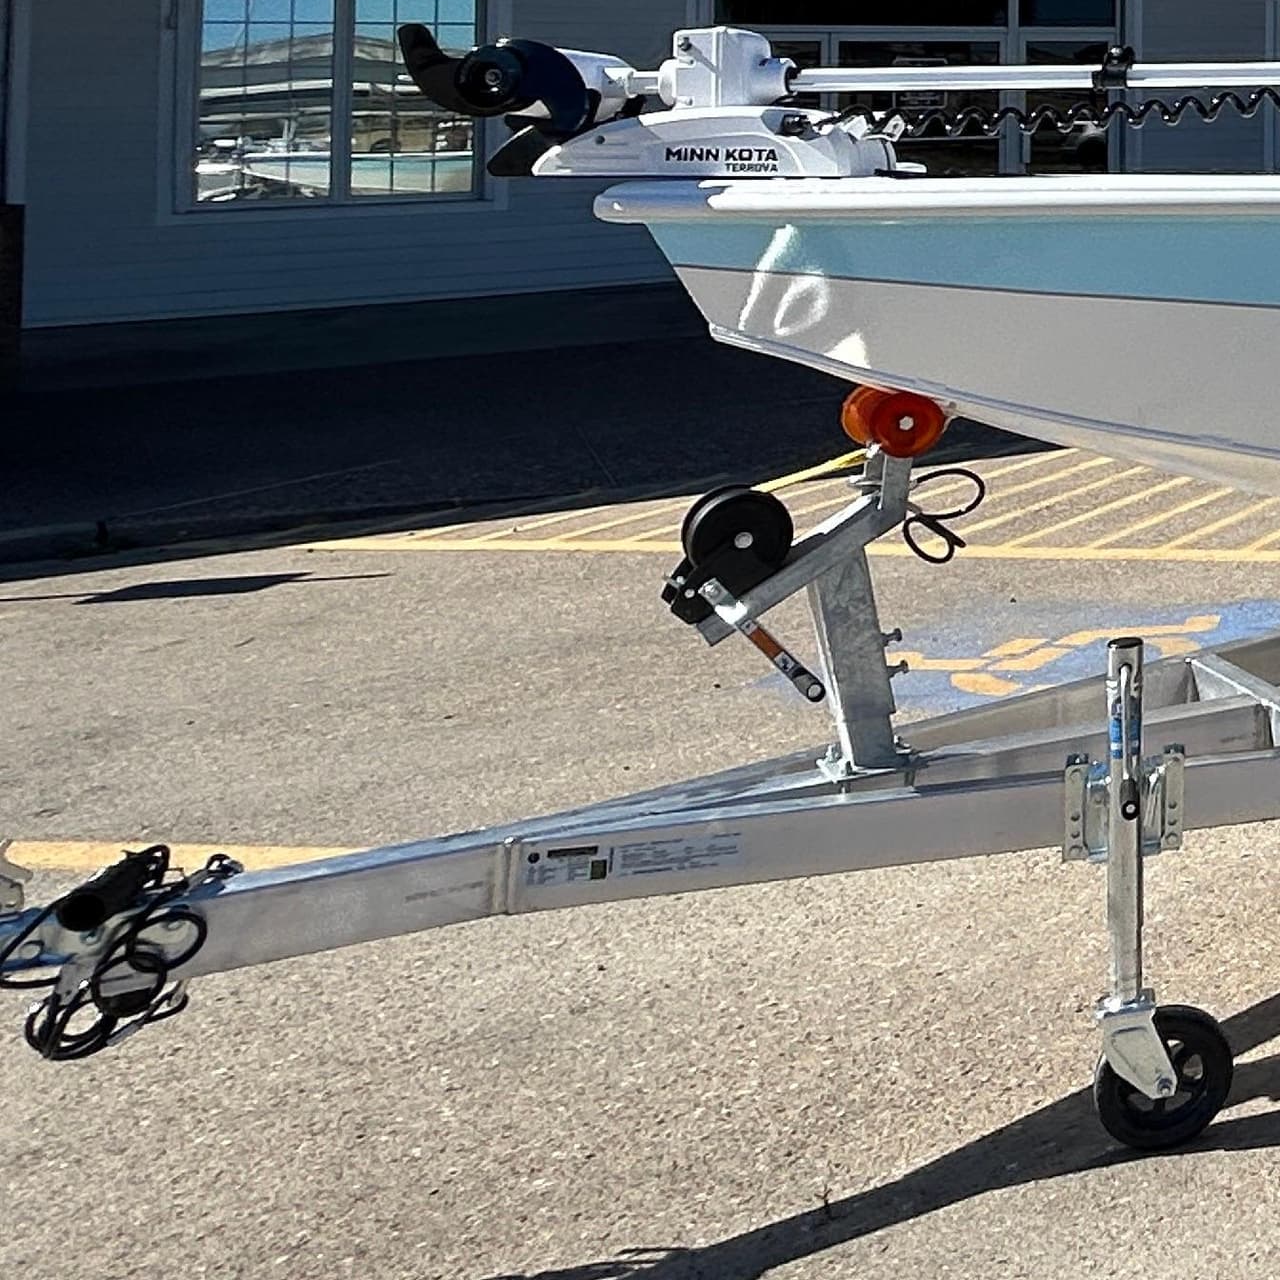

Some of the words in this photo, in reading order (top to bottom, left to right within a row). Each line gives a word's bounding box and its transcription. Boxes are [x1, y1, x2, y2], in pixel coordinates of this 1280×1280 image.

[665, 147, 720, 161] MINN
[724, 148, 778, 162] KOTA
[724, 163, 778, 173] TERROVA
